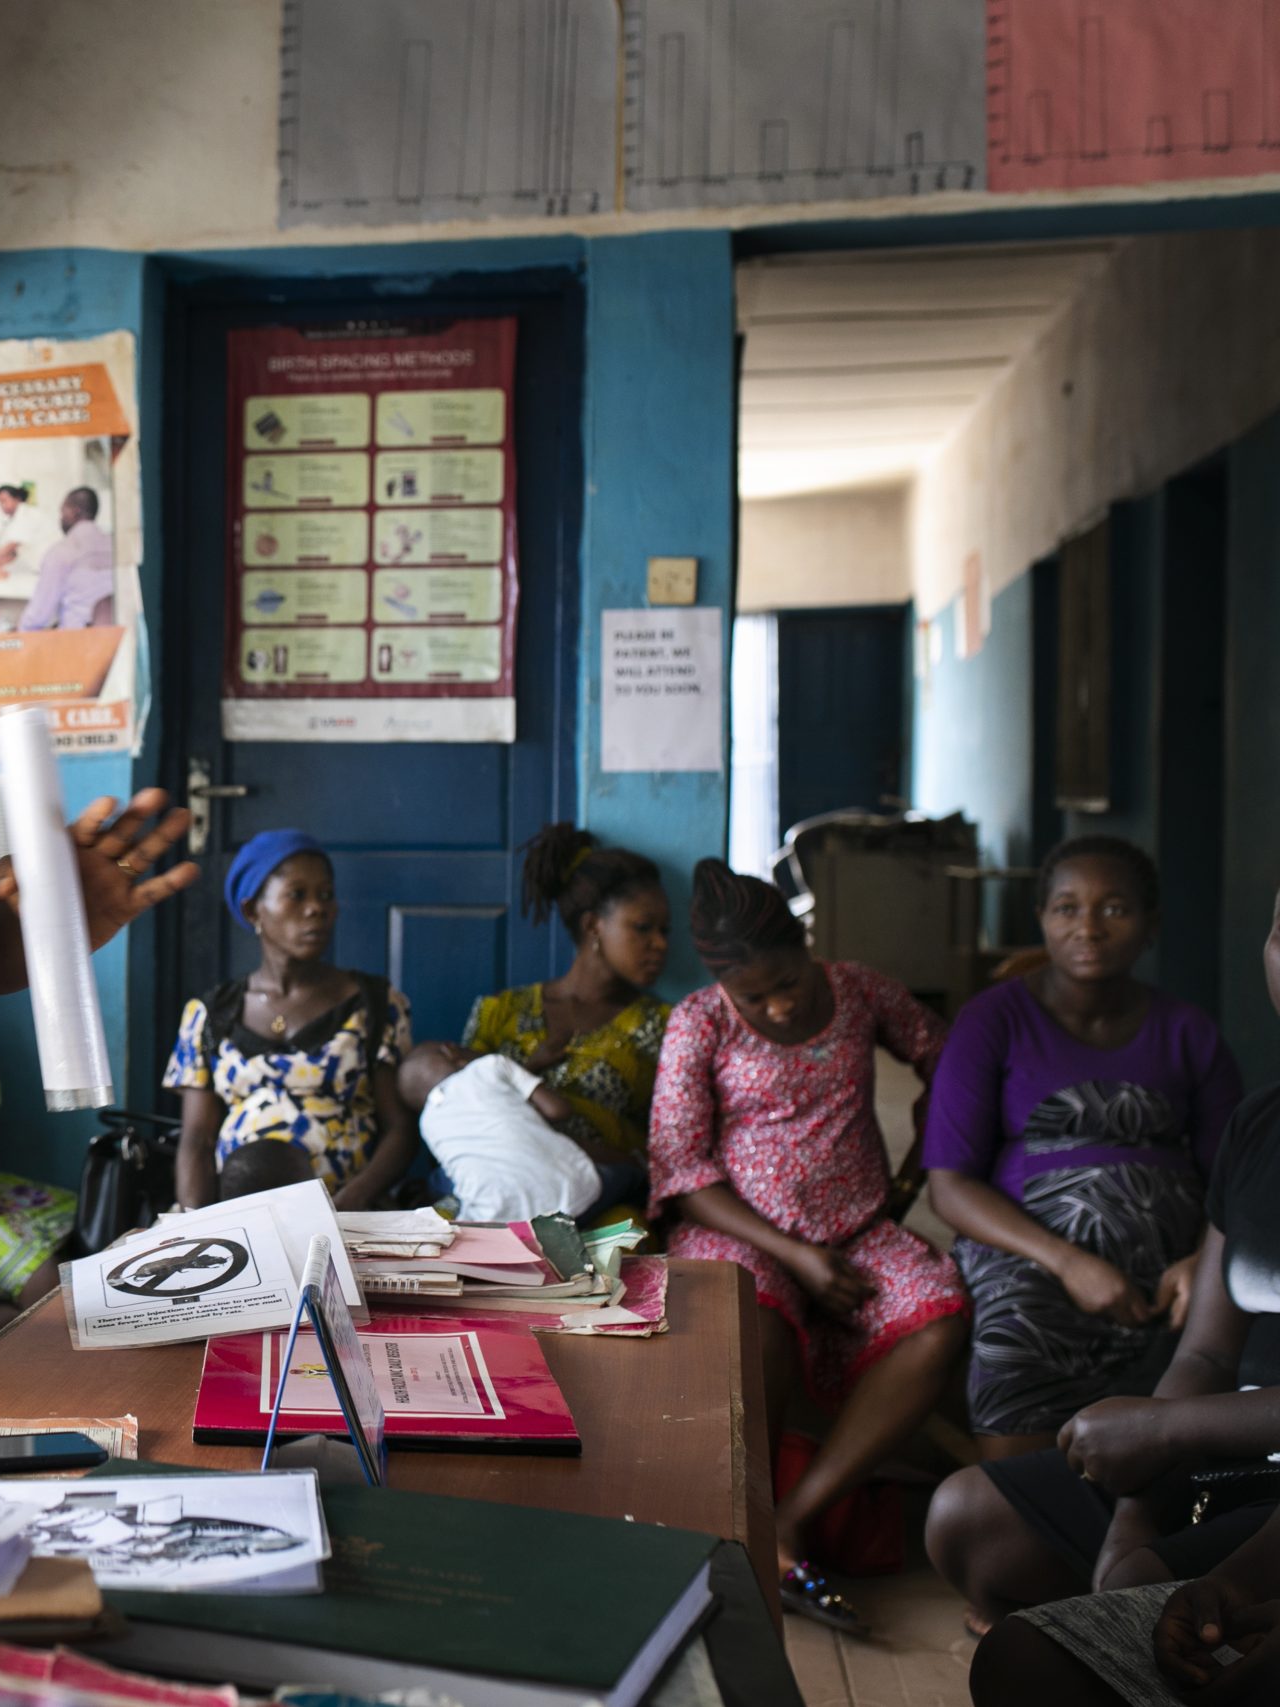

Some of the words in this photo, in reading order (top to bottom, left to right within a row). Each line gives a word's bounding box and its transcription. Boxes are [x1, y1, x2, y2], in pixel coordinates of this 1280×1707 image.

[147, 1307, 185, 1317] injection
[198, 1301, 230, 1309] vaccine
[244, 1294, 276, 1303] prevent
[134, 1319, 168, 1329] prevent
[182, 1313, 210, 1321] spread
[161, 1311, 194, 1320] prevent
